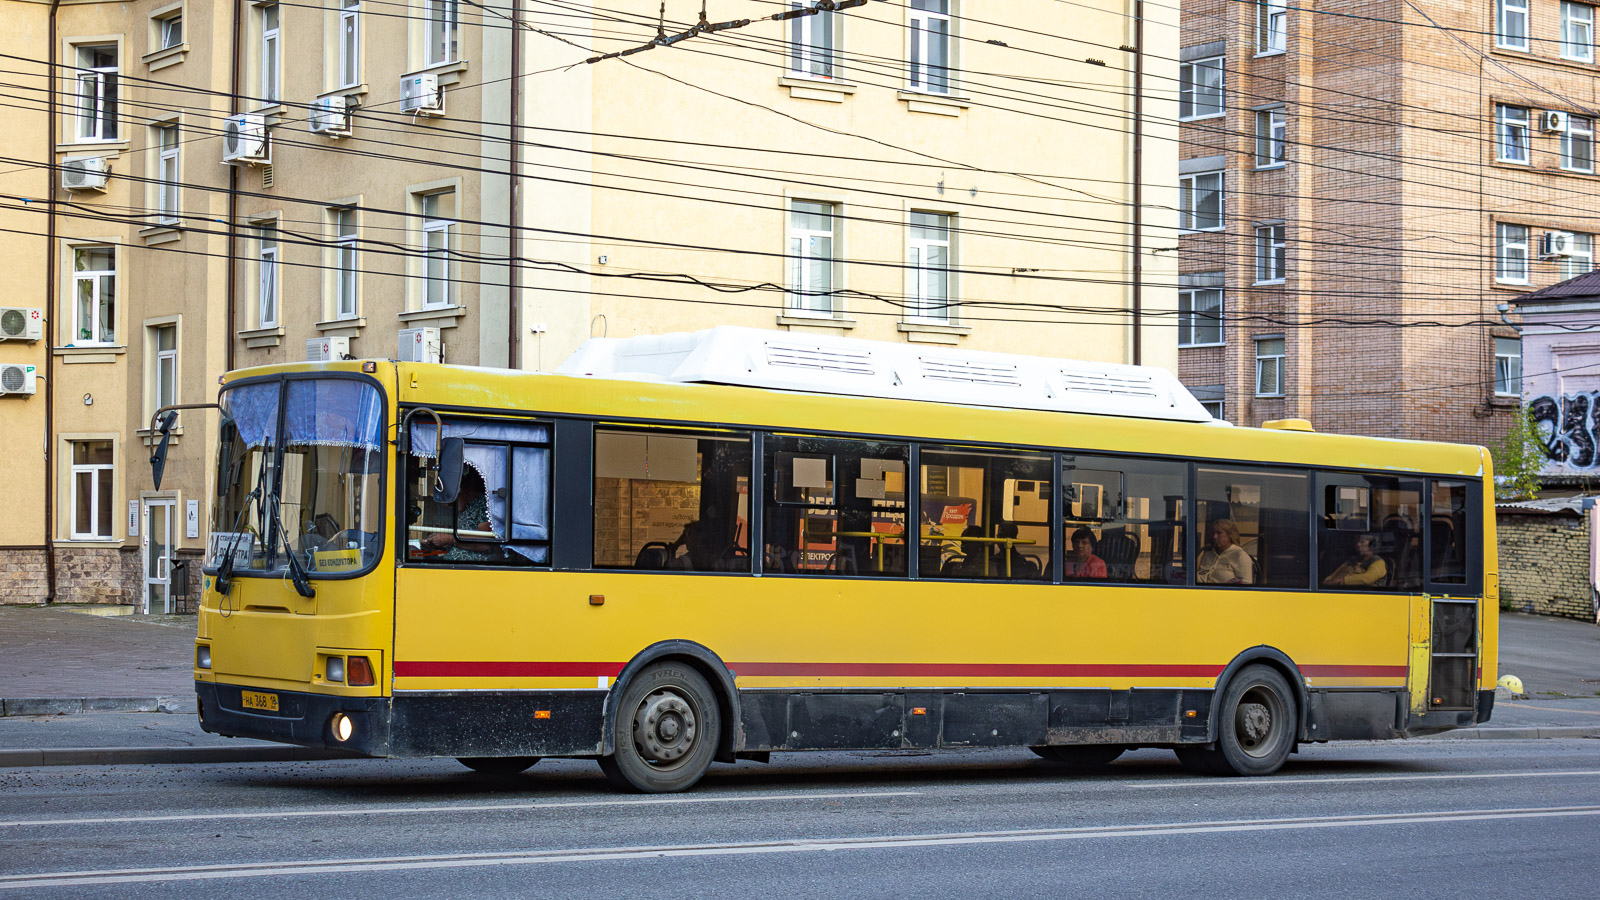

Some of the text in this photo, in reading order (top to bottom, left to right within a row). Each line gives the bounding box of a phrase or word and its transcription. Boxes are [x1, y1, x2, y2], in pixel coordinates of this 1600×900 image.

[228, 548, 248, 560] ЦНТРА
[319, 557, 358, 567] БЕЗ КОНДУКТОРА
[255, 694, 267, 708] 368
